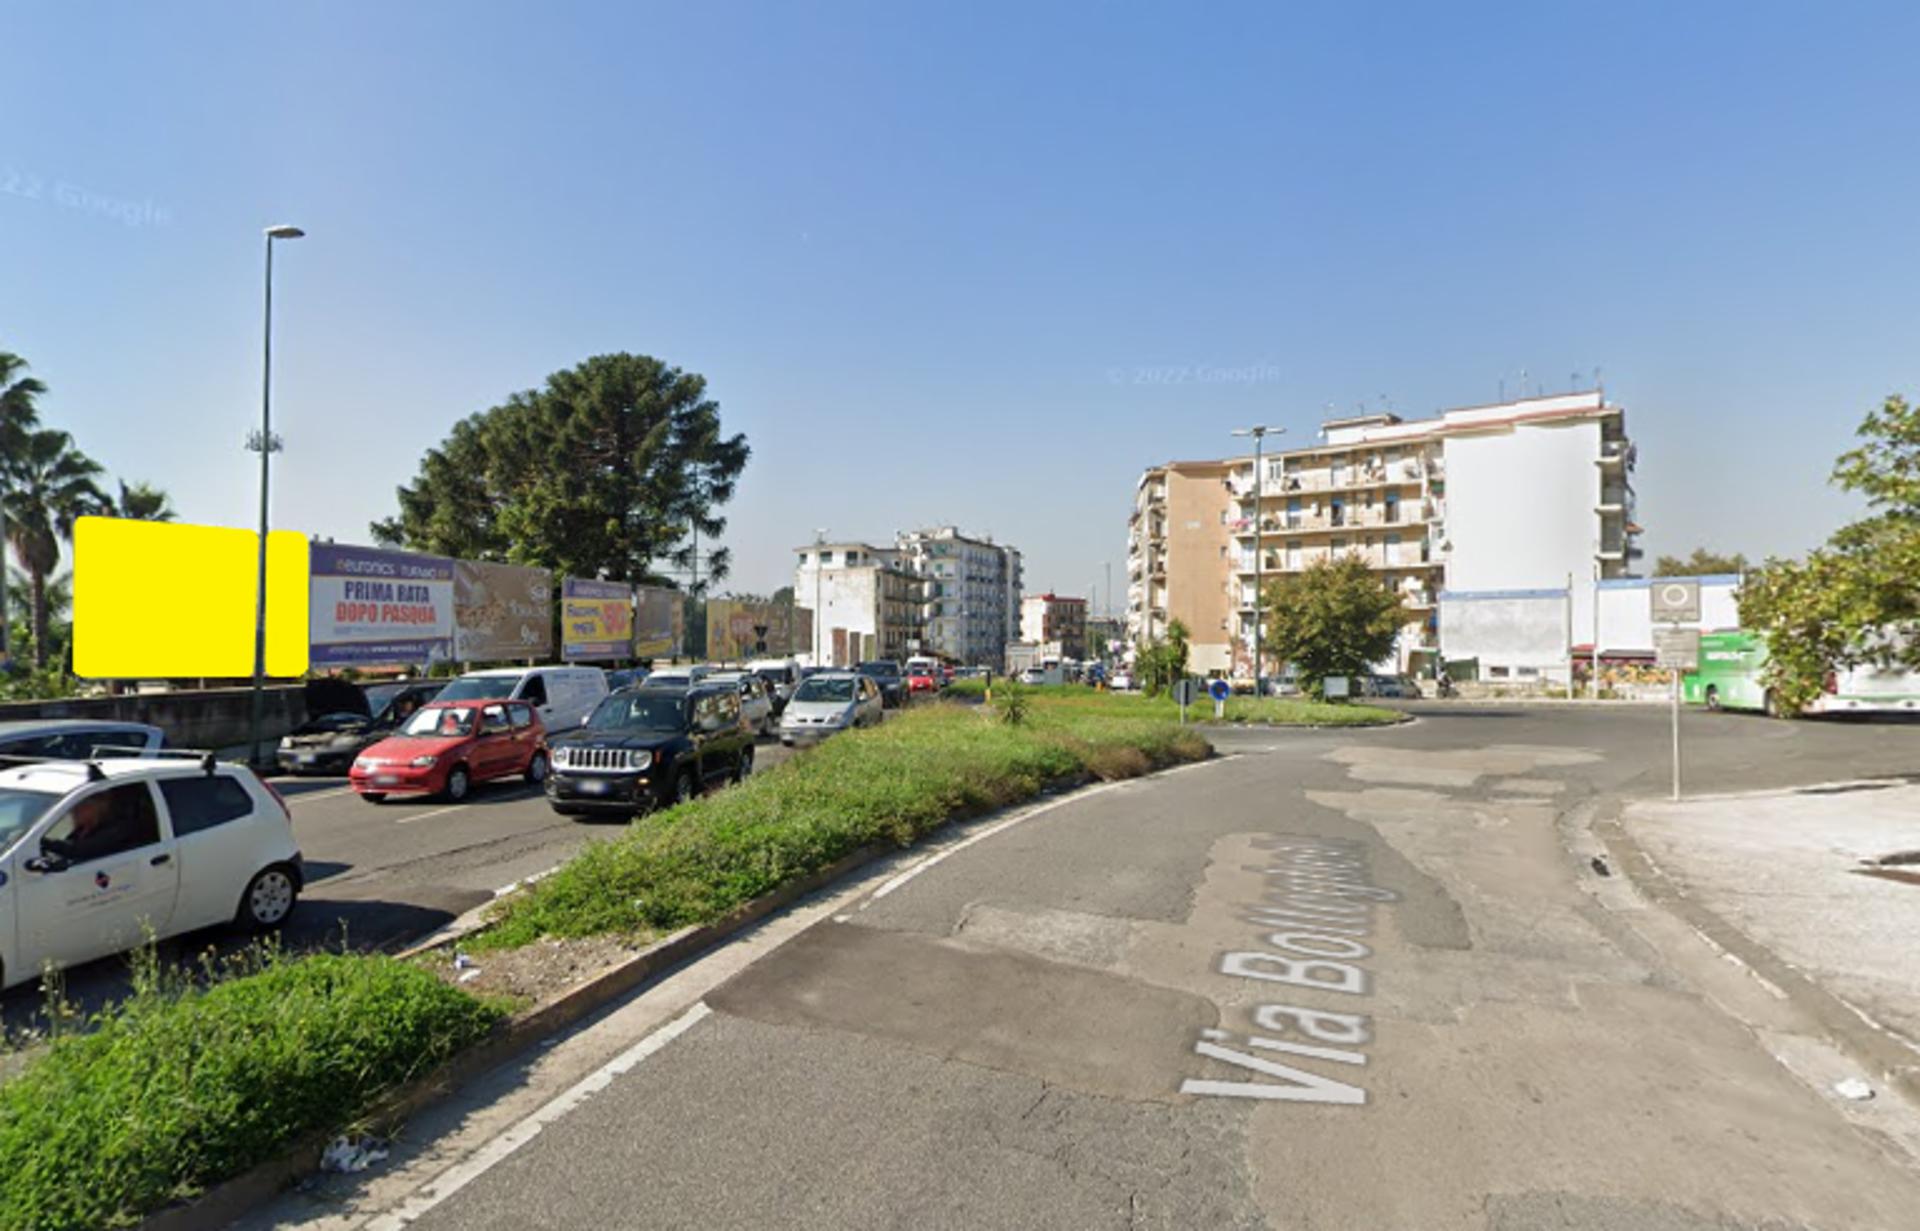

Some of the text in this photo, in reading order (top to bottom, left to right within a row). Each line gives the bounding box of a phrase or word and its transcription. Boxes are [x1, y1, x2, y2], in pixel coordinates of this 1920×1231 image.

[344, 581, 431, 604] PRIMA RATA
[335, 602, 437, 625] DOPO PASQUA
